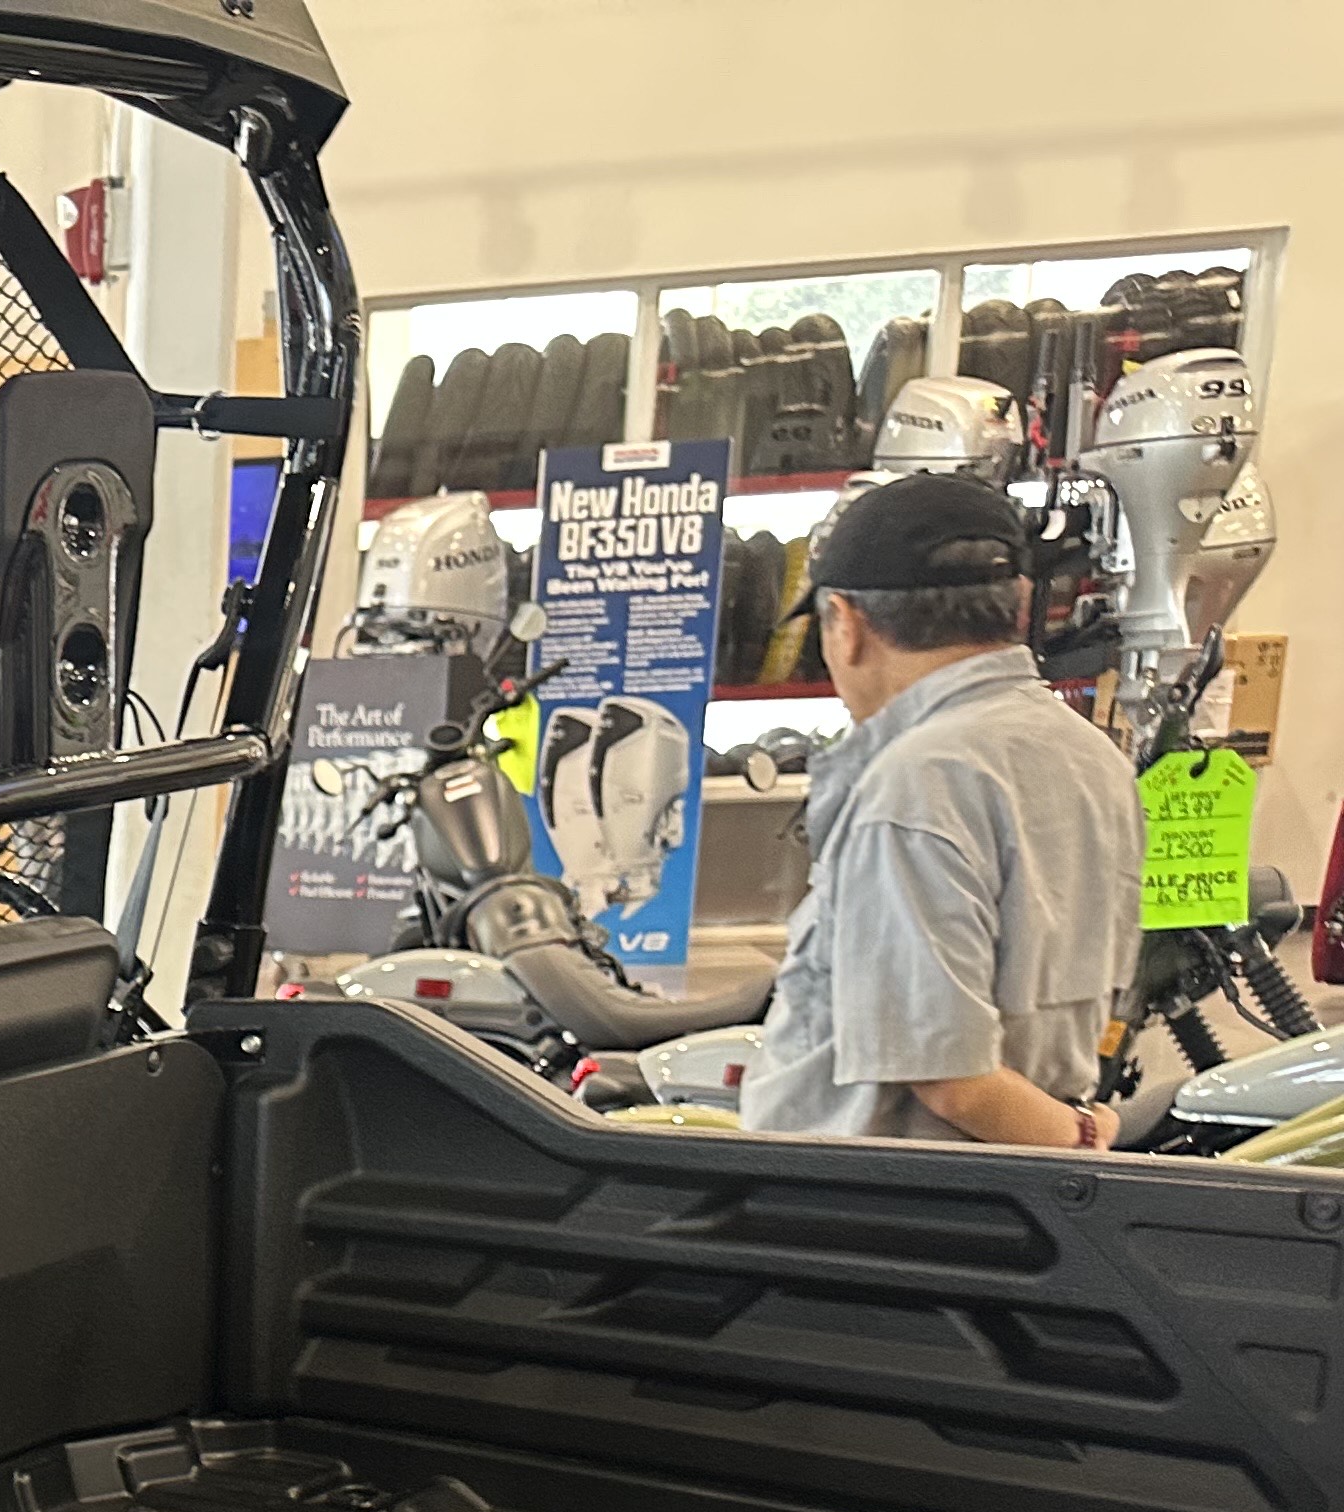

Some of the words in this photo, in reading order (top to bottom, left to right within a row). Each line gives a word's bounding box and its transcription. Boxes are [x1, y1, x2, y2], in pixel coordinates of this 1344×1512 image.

[549, 480, 618, 522] New
[620, 472, 719, 517] Honda
[558, 518, 658, 561] BF350
[661, 514, 704, 556] V8
[565, 562, 600, 580] The
[546, 577, 595, 596] Been
[597, 573, 669, 593] Waiting
[316, 702, 349, 727] The
[351, 704, 382, 726] Art
[383, 701, 407, 727] of
[308, 724, 414, 748] Performance
[1144, 873, 1179, 889] ALE
[1184, 869, 1238, 888] PRICE
